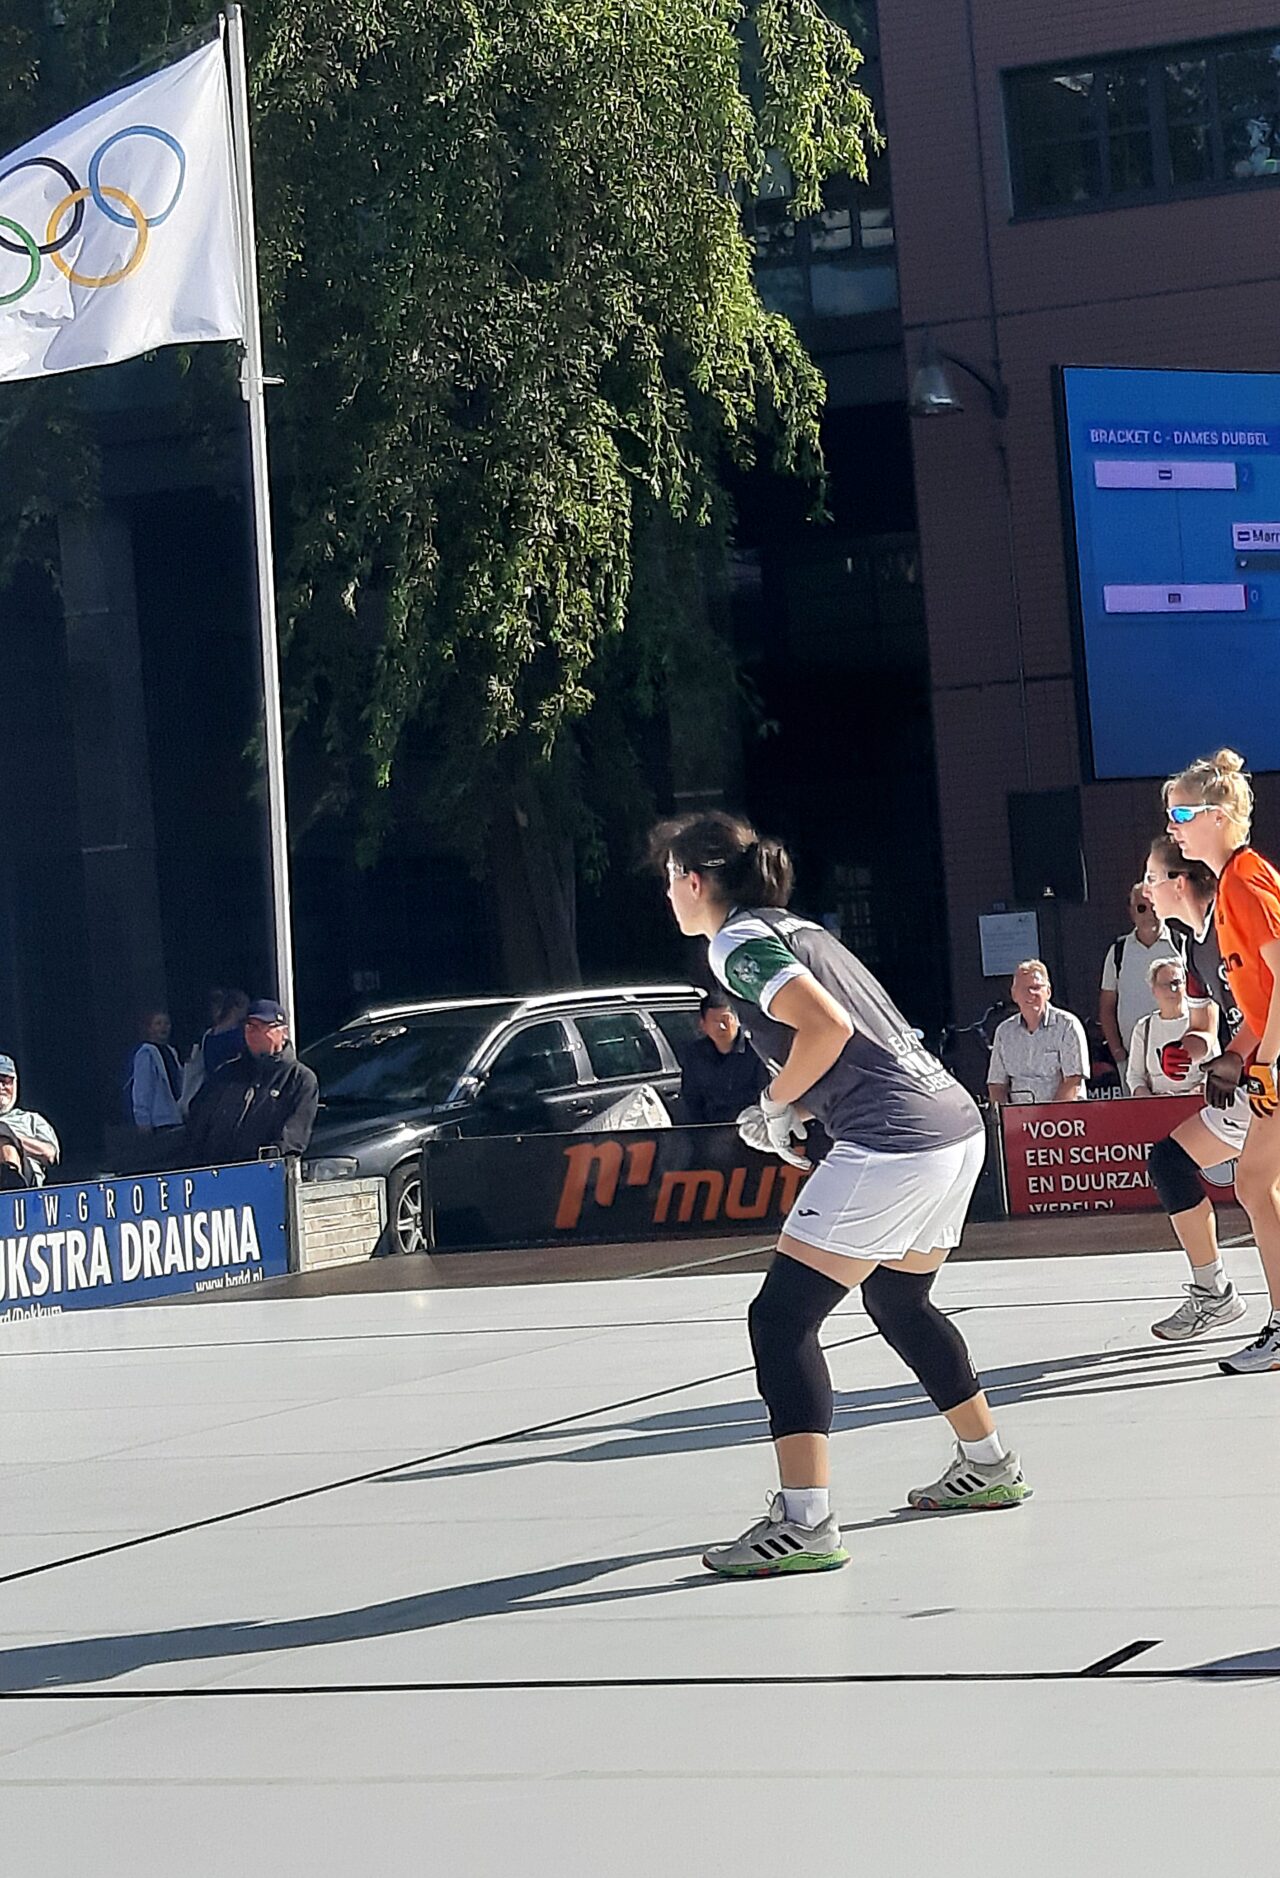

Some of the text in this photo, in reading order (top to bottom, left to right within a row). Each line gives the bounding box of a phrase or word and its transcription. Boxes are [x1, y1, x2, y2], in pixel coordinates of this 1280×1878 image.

[1090, 429, 1150, 444] BRACKET
[1153, 431, 1162, 444] C
[1174, 431, 1218, 445] DAMES
[1222, 432, 1269, 446] DUBBEL
[1022, 1119, 1086, 1140] 'VOOR
[1026, 1148, 1064, 1167] EEN
[1028, 1176, 1054, 1194] EN
[120, 1205, 262, 1283] DRAISMA
[195, 1266, 263, 1293] wwwbddnl
